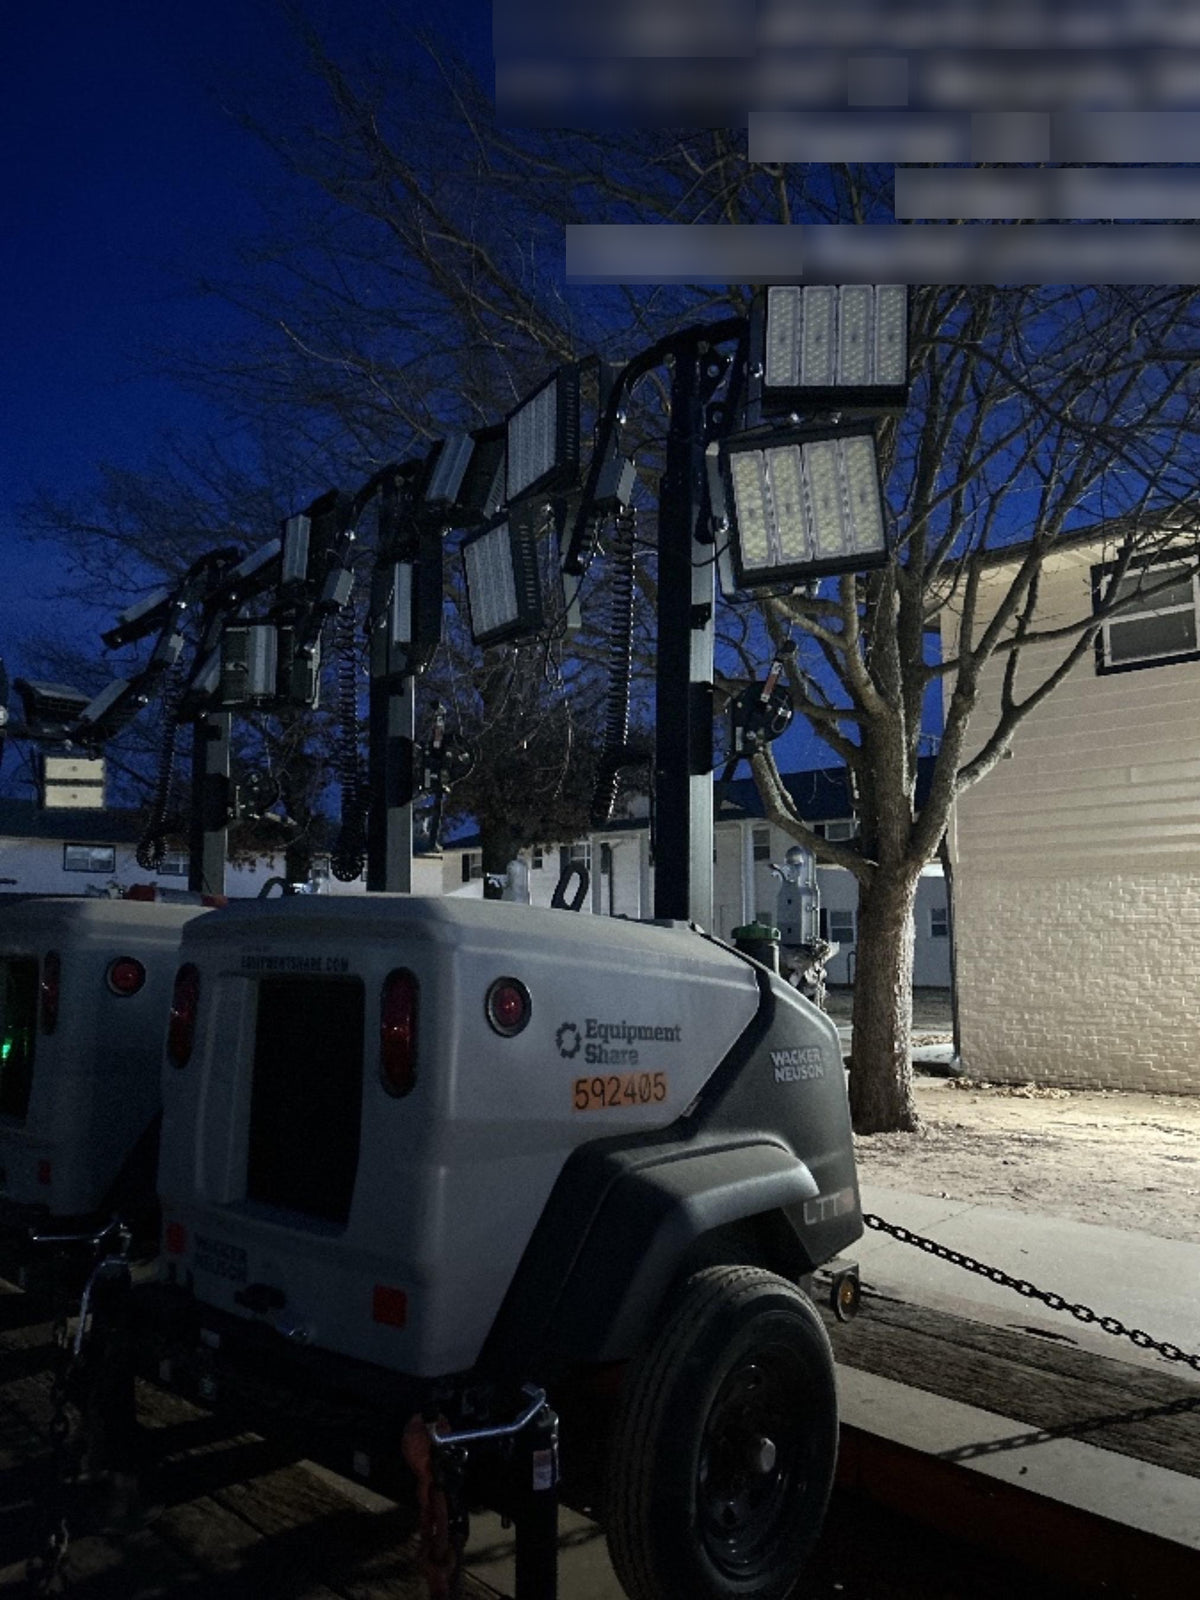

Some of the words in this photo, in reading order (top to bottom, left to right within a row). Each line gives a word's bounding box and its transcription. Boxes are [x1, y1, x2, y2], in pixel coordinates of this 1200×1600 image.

[585, 1018, 682, 1044] Equipment
[585, 1043, 639, 1065] Share
[770, 1047, 820, 1067] WACKER
[774, 1064, 824, 1083] NEUSON
[575, 1072, 666, 1110] 592405
